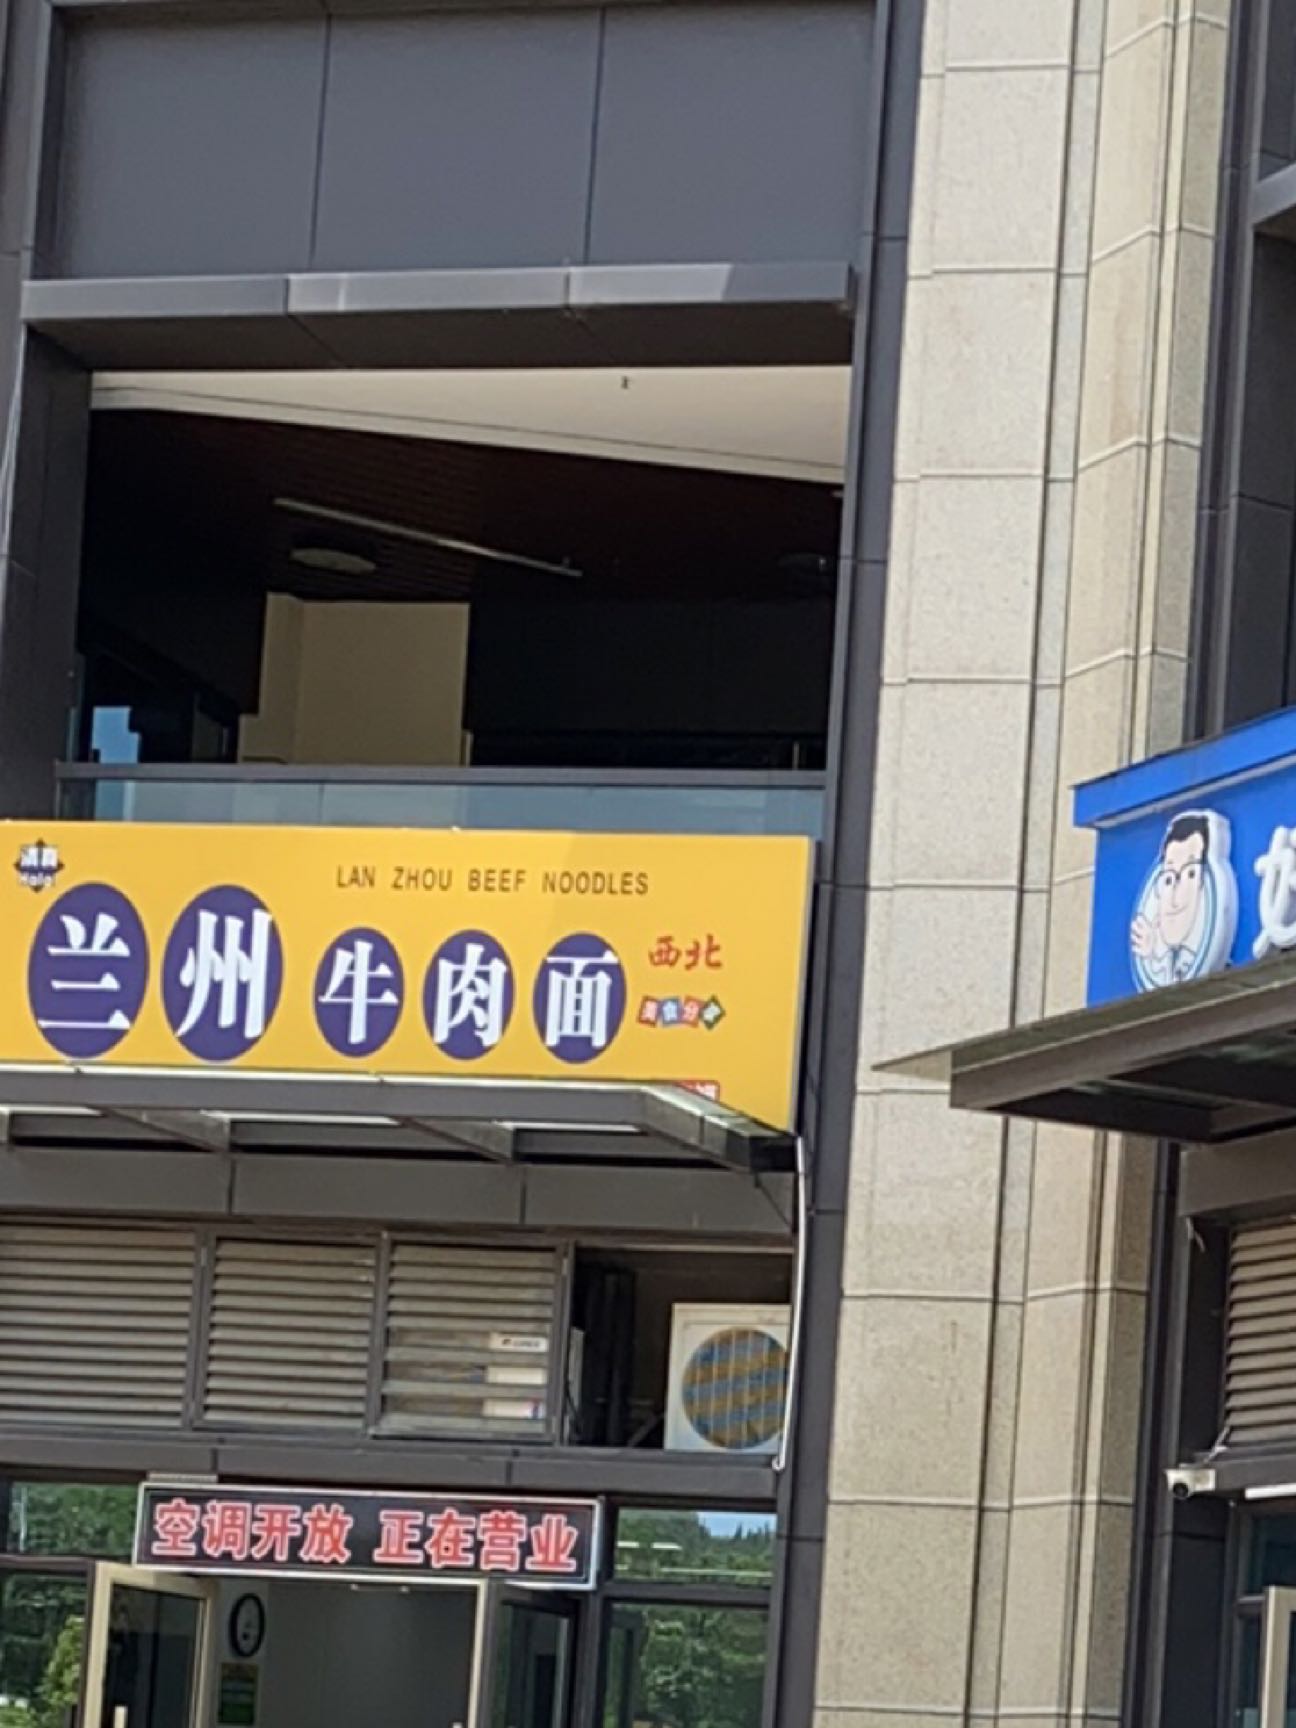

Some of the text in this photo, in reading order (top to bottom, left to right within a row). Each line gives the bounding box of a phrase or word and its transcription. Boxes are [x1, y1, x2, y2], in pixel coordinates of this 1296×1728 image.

[336, 866, 650, 896] LAN ZHOU BEEF NOODLES
[38, 908, 619, 1049] 兰州牛肉面
[648, 933, 723, 971] 西北
[151, 1497, 579, 1572] 空调开放 正在营业
